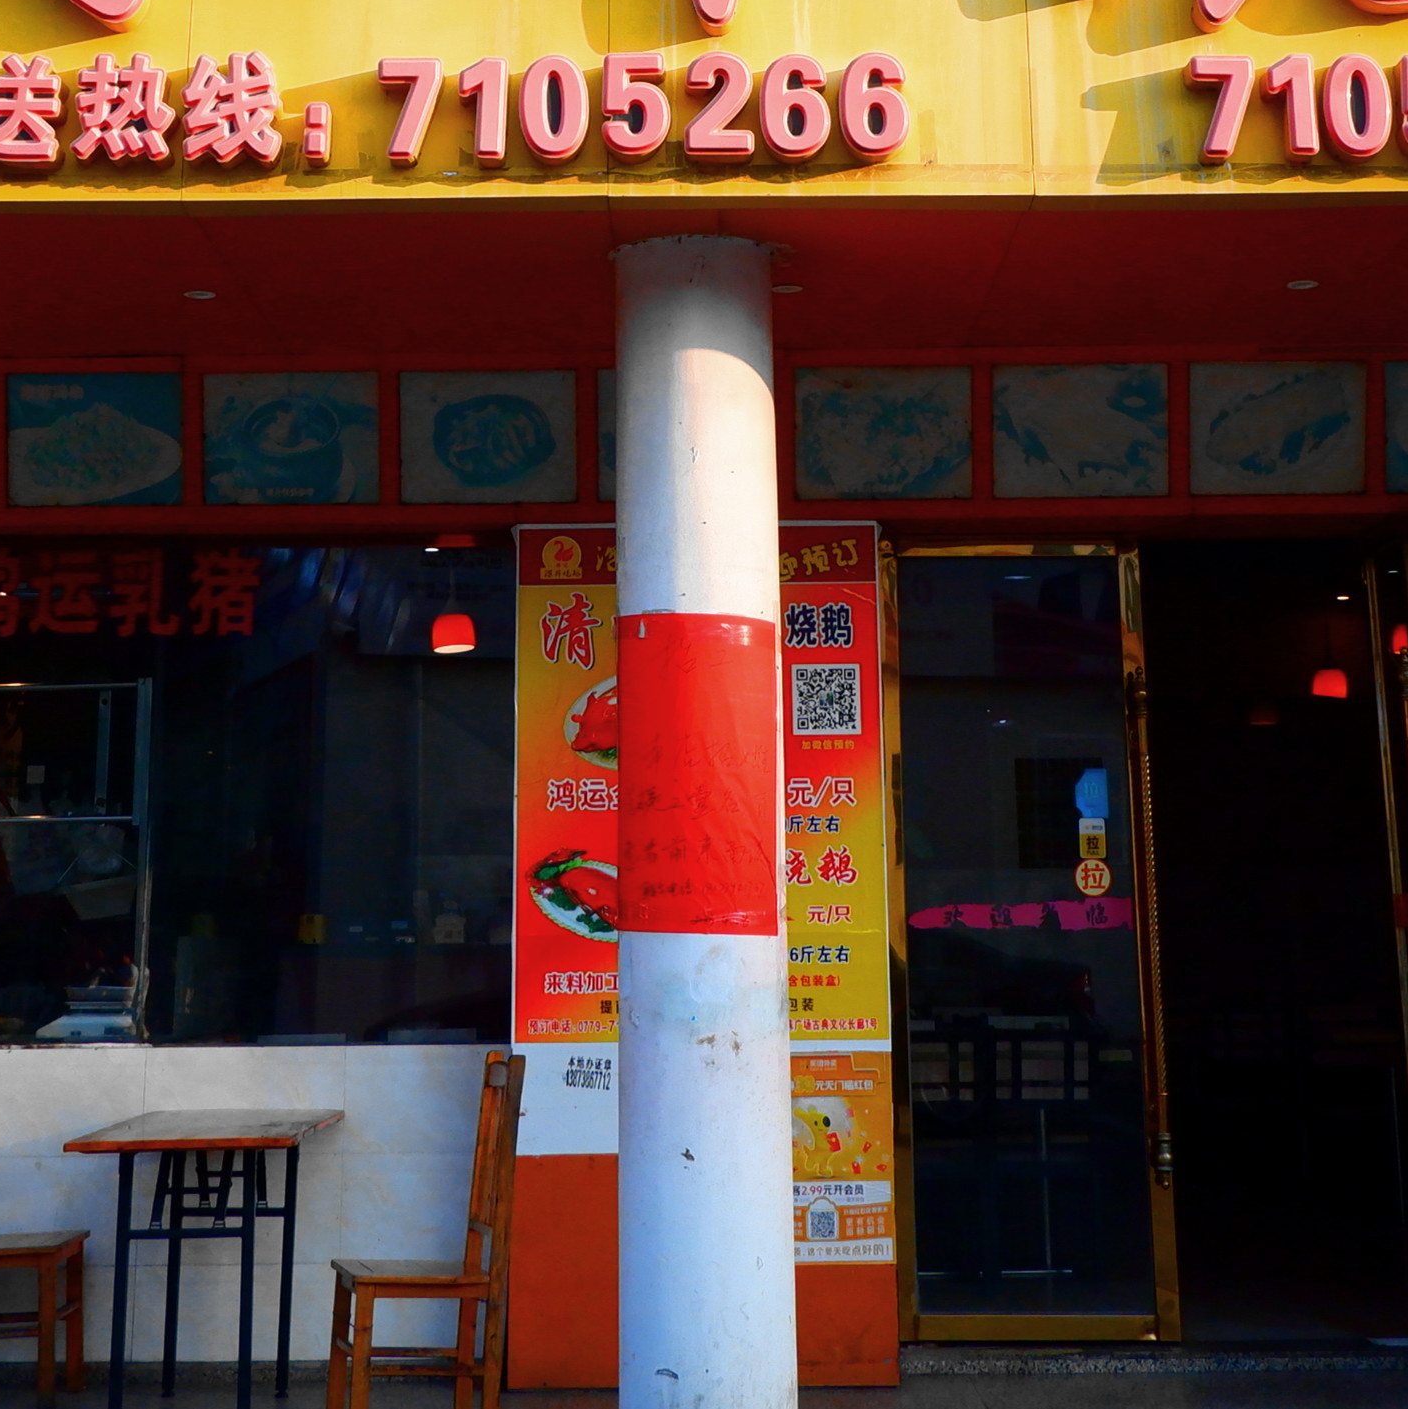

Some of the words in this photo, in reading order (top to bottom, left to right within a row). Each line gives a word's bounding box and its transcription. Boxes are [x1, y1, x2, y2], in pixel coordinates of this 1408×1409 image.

[376, 50, 911, 169] 7105266
[539, 592, 602, 670] 清
[785, 602, 853, 649] 烧鹅
[788, 776, 857, 808] 元/只
[1086, 835, 1100, 850] 拉
[1080, 863, 1106, 890] 拉
[807, 904, 852, 925] 元/只
[789, 944, 850, 963] 6斤左右
[544, 971, 619, 994] 来料加工
[600, 1000, 619, 1014] 提
